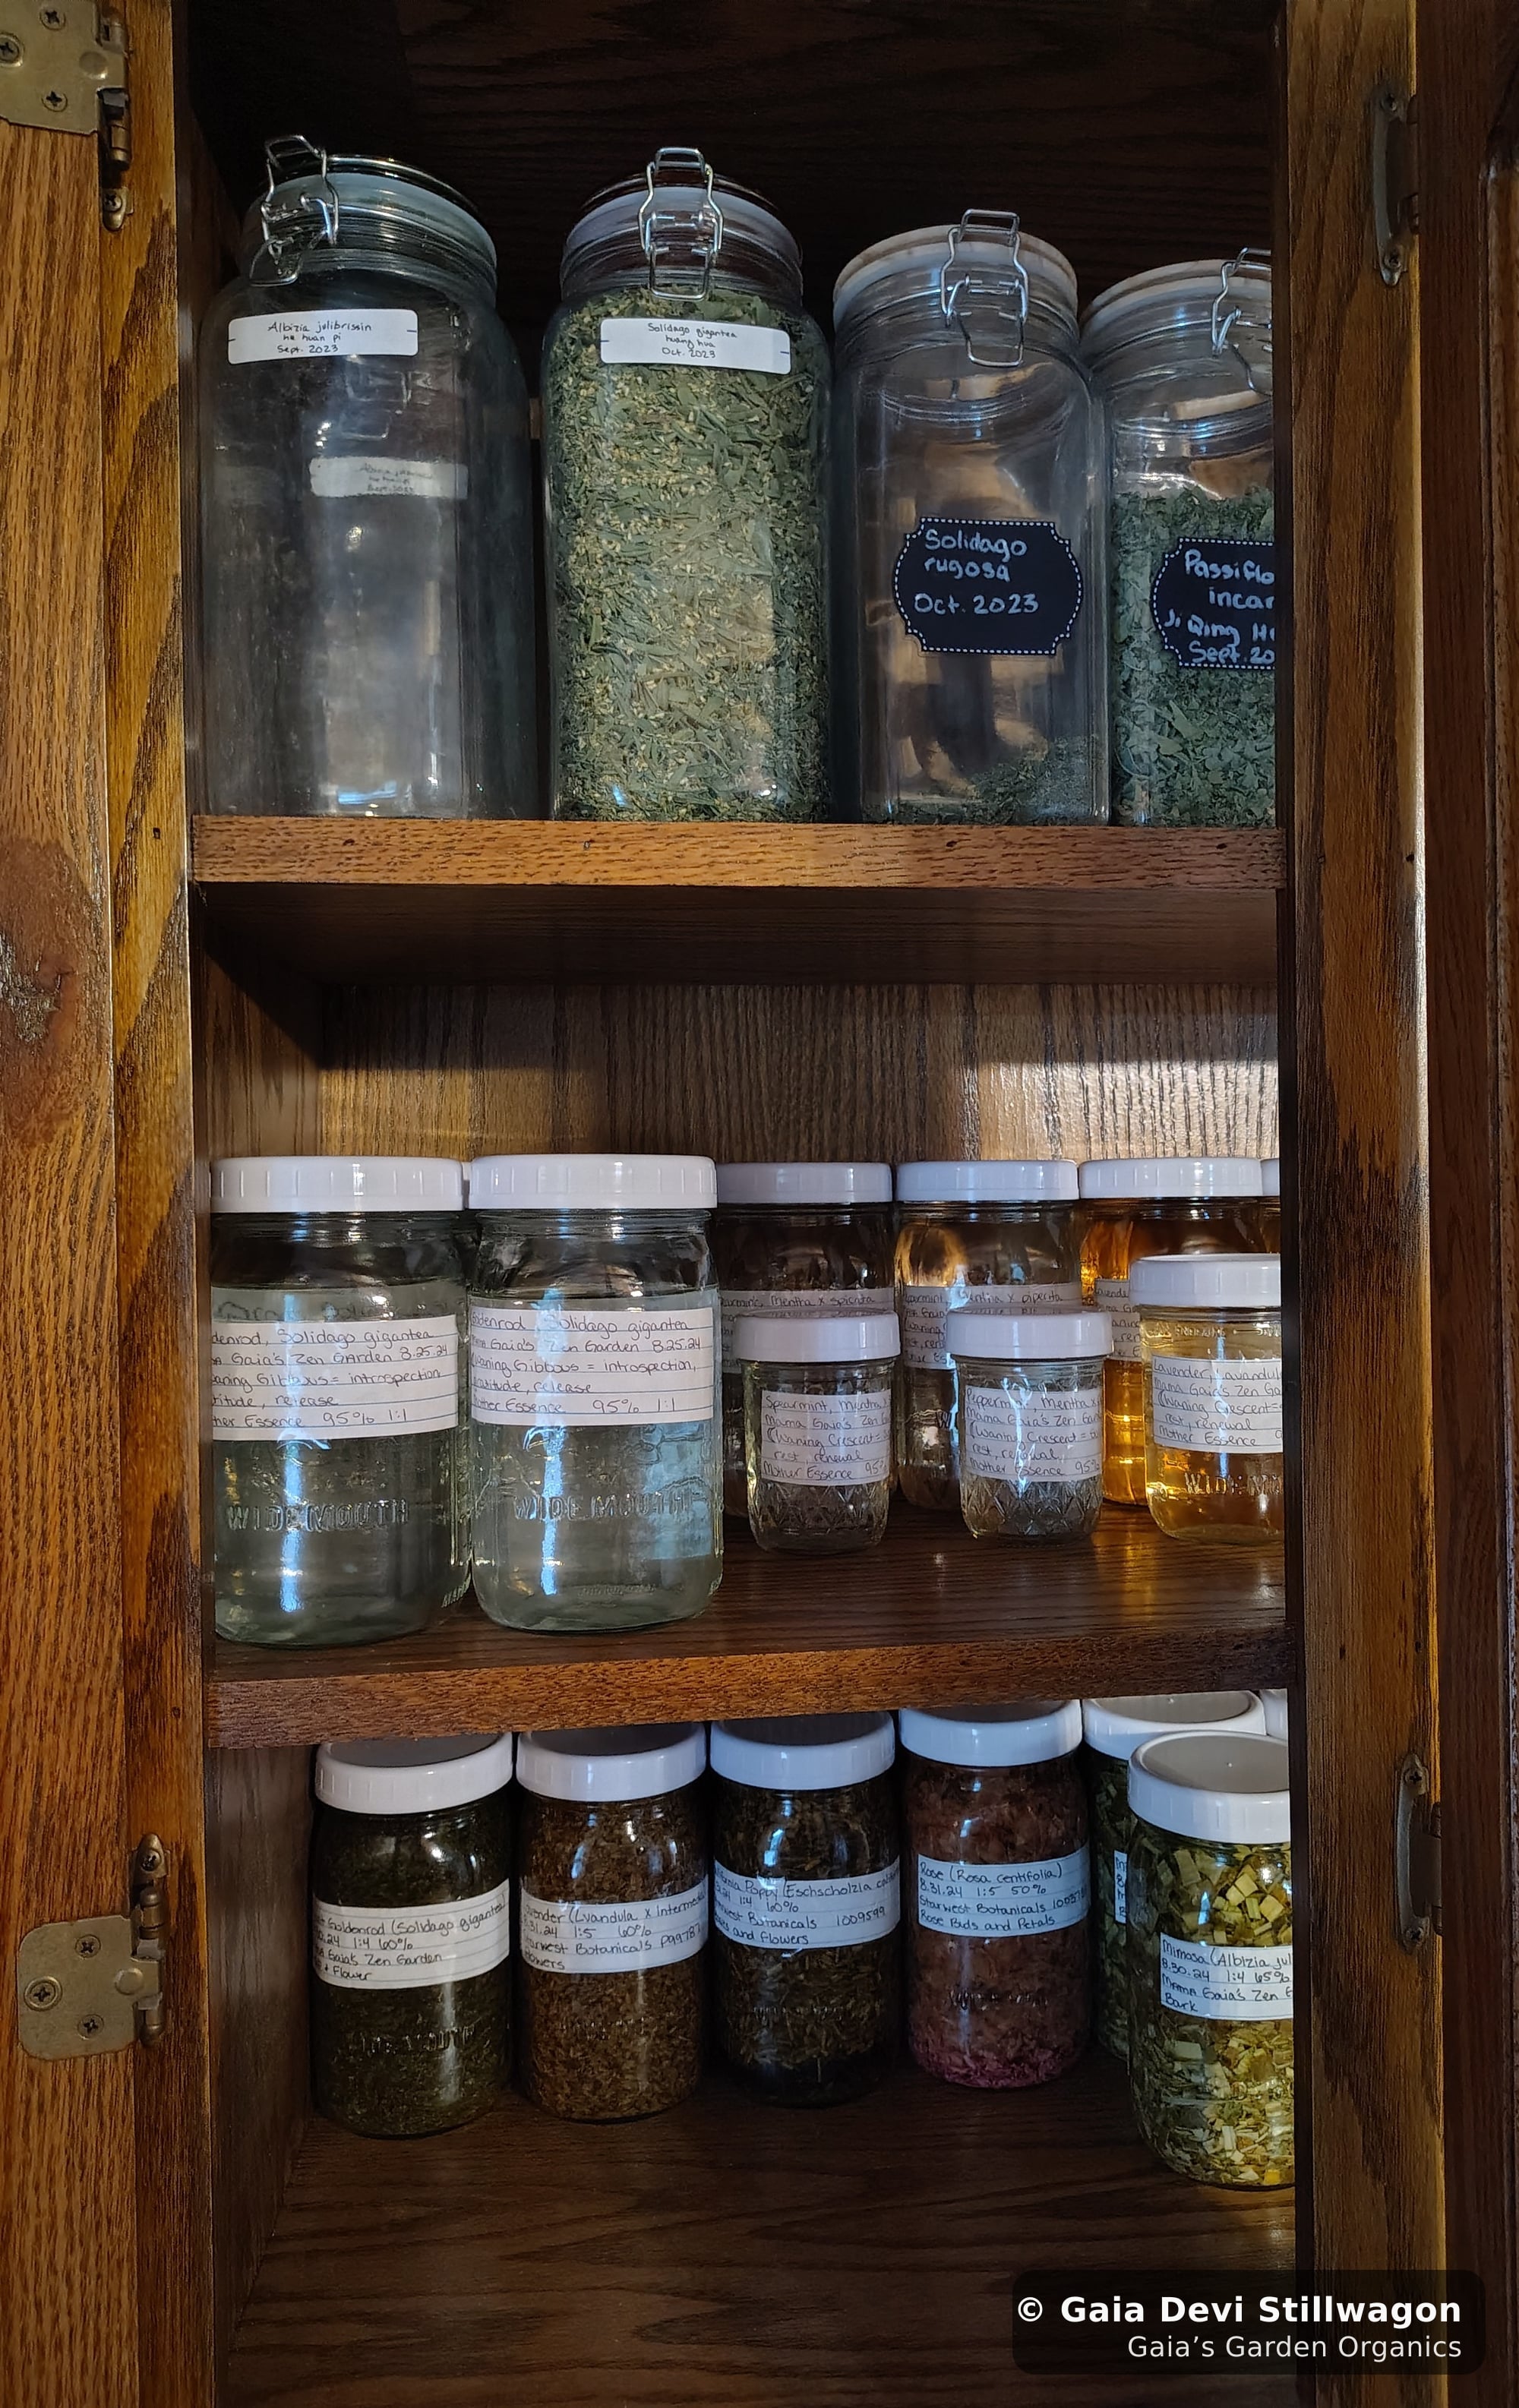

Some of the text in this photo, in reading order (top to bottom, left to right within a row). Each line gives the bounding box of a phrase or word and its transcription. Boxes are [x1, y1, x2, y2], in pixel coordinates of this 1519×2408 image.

[267, 321, 310, 333] Albizia
[647, 322, 690, 336] Solidago
[308, 344, 339, 354] 2023
[690, 349, 716, 358] 2023
[924, 529, 1028, 563] Solidago
[924, 557, 1011, 582] rugosa
[973, 593, 1039, 615] 2023
[543, 1313, 617, 1339] Solidago
[627, 1319, 693, 1341] gigantea
[277, 1329, 356, 1349] Solidago
[365, 1328, 435, 1349] gigantea
[490, 1338, 535, 1352] Gaia's
[585, 1341, 640, 1353] Garden
[231, 1352, 286, 1366] Gaia's
[291, 1353, 325, 1365] Zen
[513, 1358, 579, 1374] Gibbous
[1235, 1384, 1260, 1397] Zen
[505, 1397, 567, 1414] Essence
[592, 1398, 640, 1415] 95%
[245, 1413, 305, 1428] Essence
[323, 1411, 375, 1426] 95%
[1053, 1414, 1077, 1428] Zen
[1204, 1431, 1259, 1447] Essence
[1011, 1883, 1047, 1895] 50%
[977, 1901, 1047, 1916] Botanicals
[984, 1919, 1012, 1932] and
[575, 1939, 652, 1956] Botanicals
[1162, 1939, 1211, 1965] Mimosa
[365, 1953, 391, 1967] Zen
[396, 1952, 443, 1966] Garden
[1164, 1991, 1199, 2013] Bark
[1251, 1990, 1279, 2002] Zen
